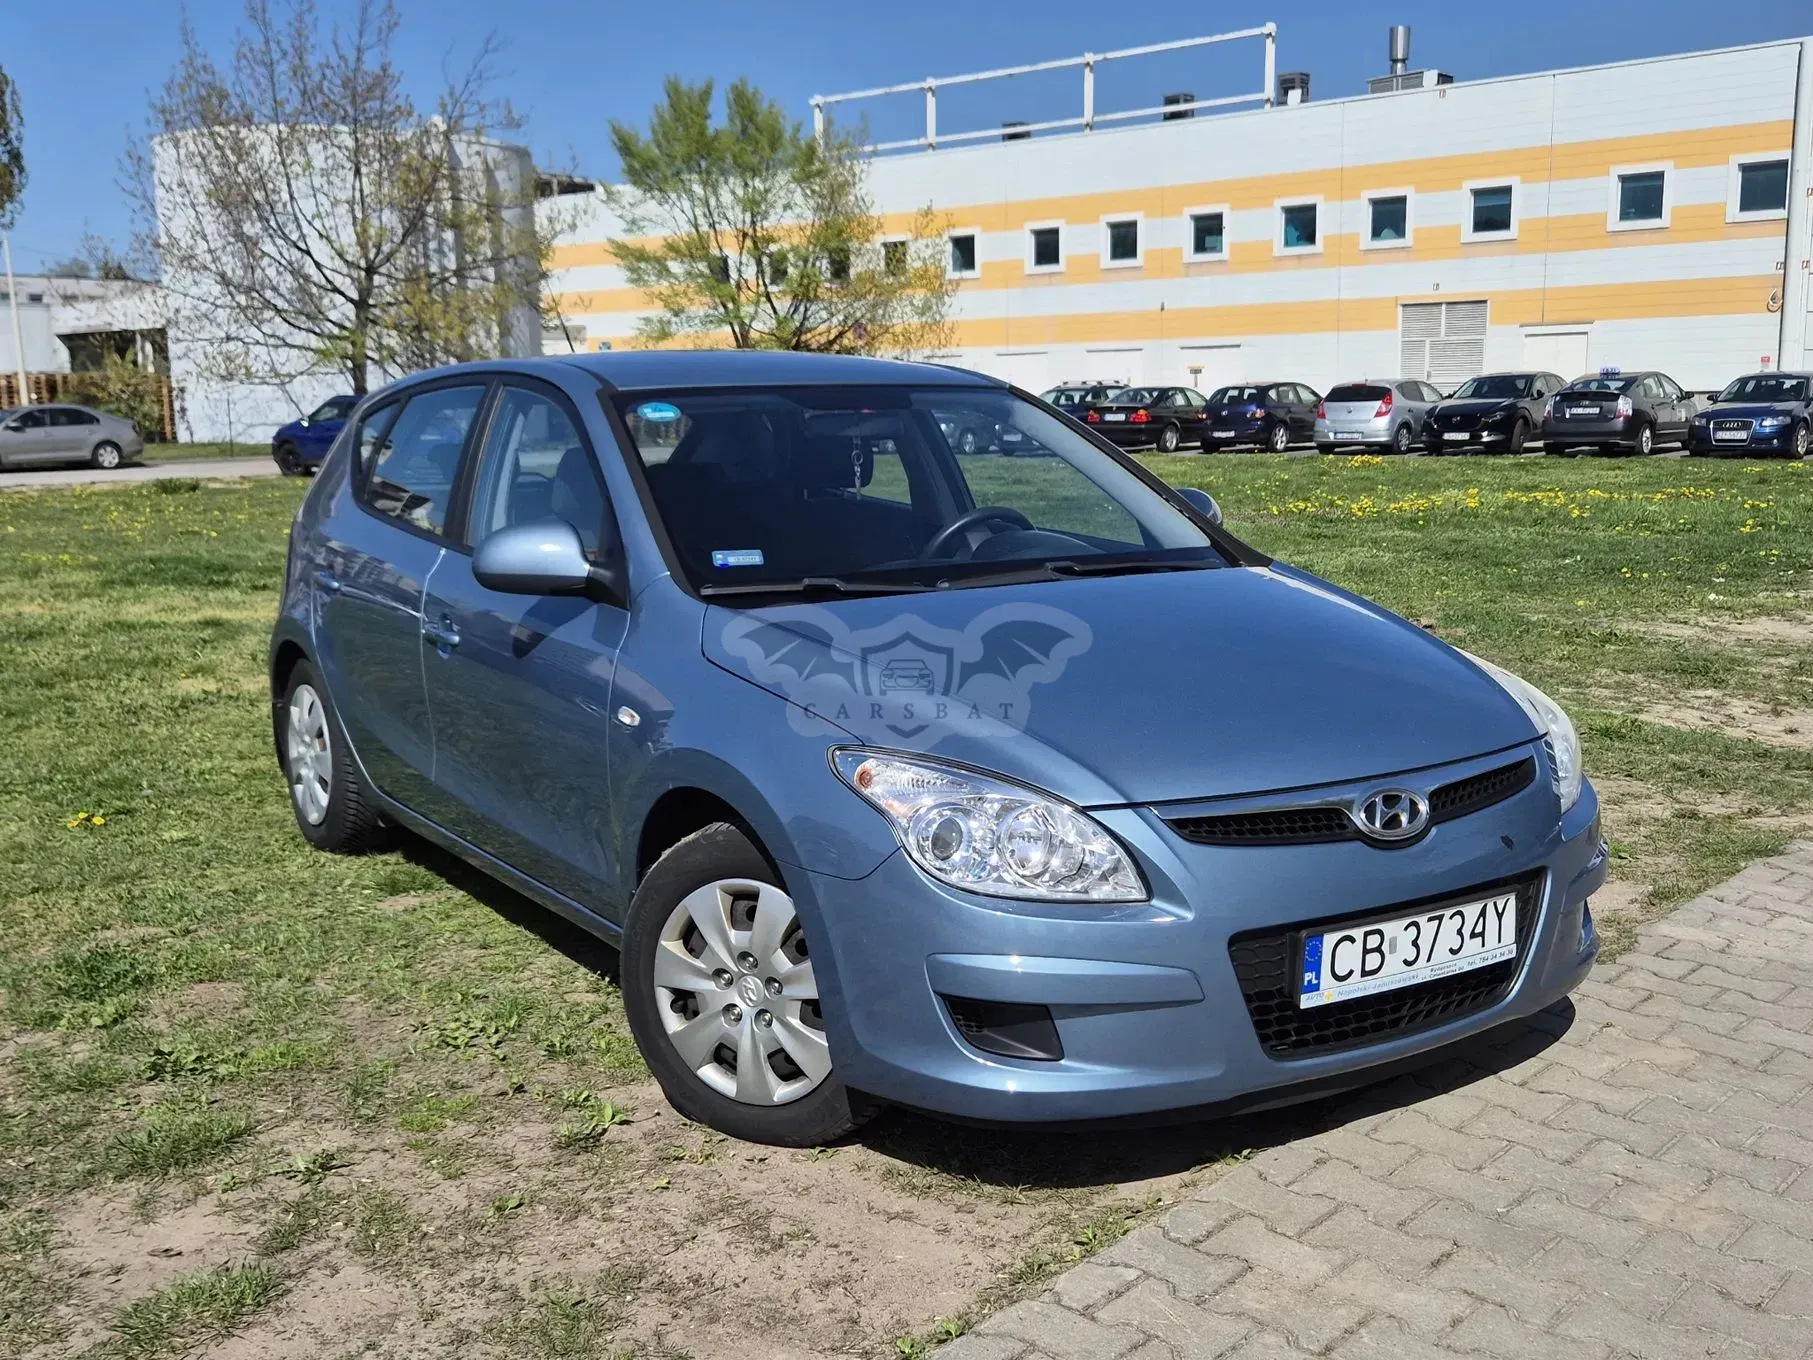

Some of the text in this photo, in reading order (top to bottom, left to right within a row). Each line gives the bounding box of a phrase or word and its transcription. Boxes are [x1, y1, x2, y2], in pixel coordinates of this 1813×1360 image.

[1330, 897, 1511, 983] CB 3734Y
[1304, 972, 1318, 986] PL
